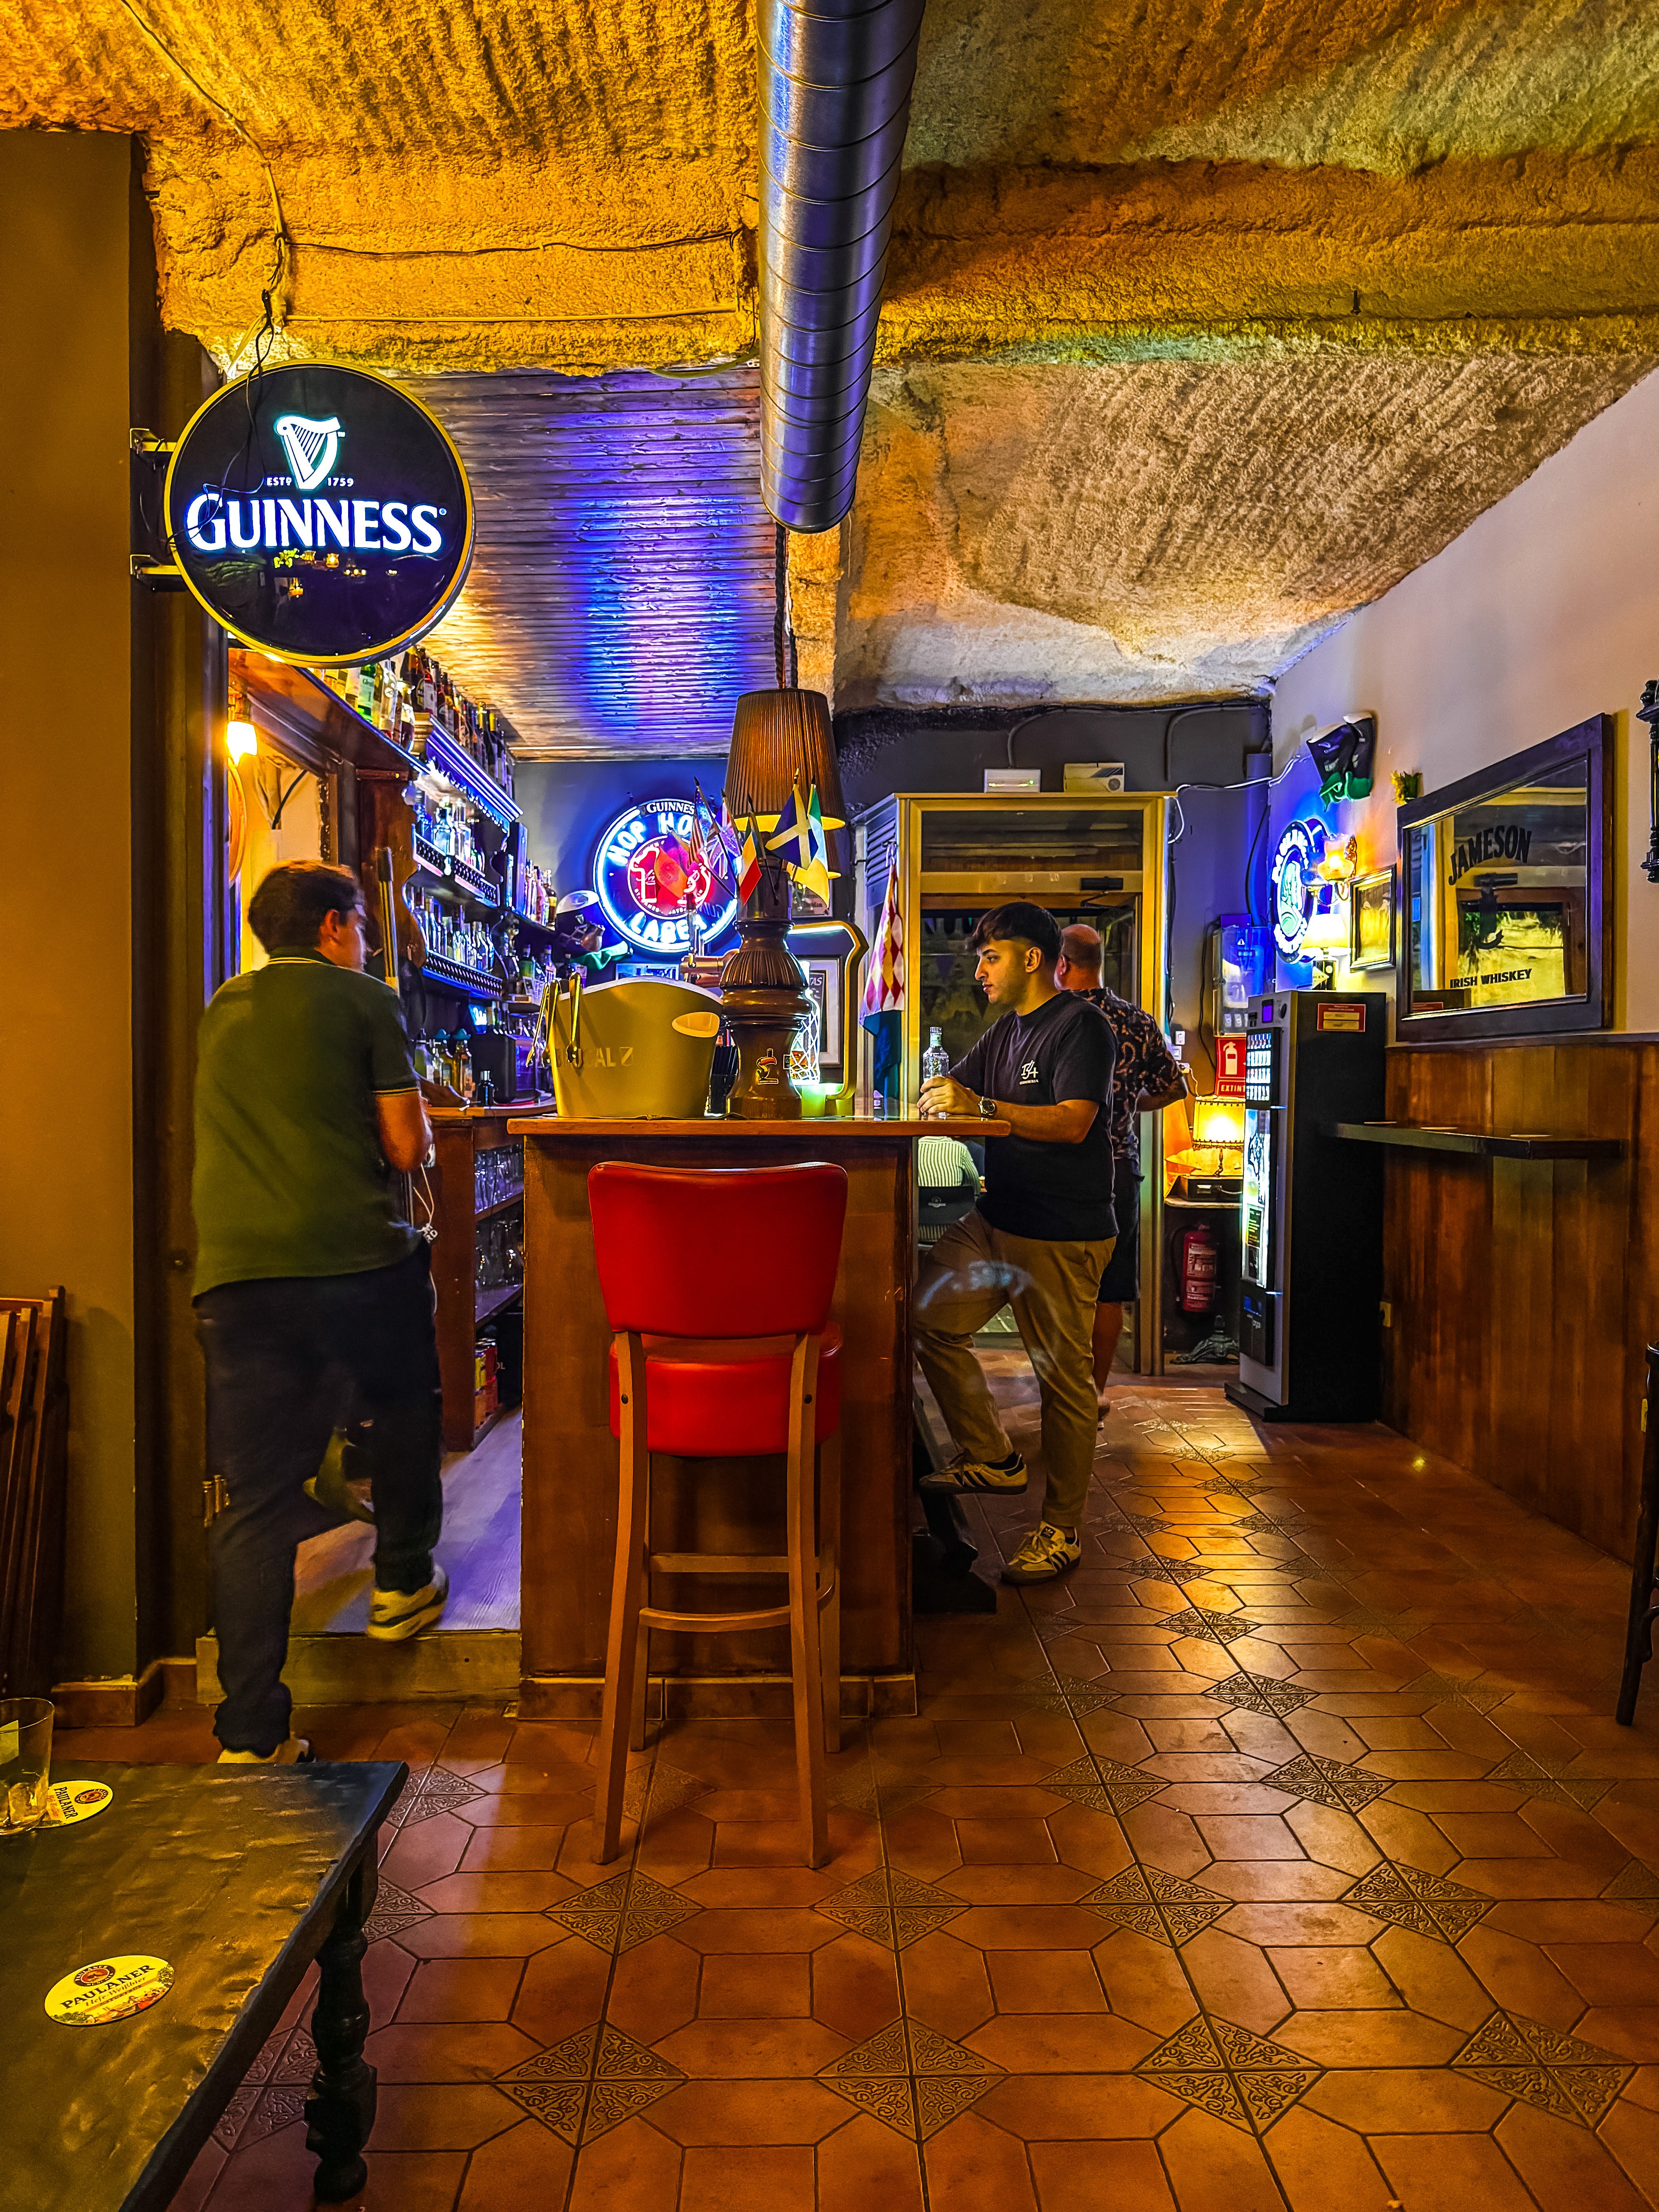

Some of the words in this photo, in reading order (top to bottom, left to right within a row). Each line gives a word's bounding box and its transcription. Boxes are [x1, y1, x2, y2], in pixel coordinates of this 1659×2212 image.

[327, 477, 354, 487] 1759
[186, 492, 442, 554] GUINNESS
[646, 801, 695, 815] GUINNES
[607, 820, 645, 865] HOP
[1448, 825, 1532, 886] JAMESON
[1450, 976, 1478, 989] IRISH
[1480, 968, 1532, 985] WHISKEY
[1220, 1084, 1246, 1092] EXTINT
[54, 1786, 78, 1819] PAULANER
[59, 1965, 156, 2009] PAULANER
